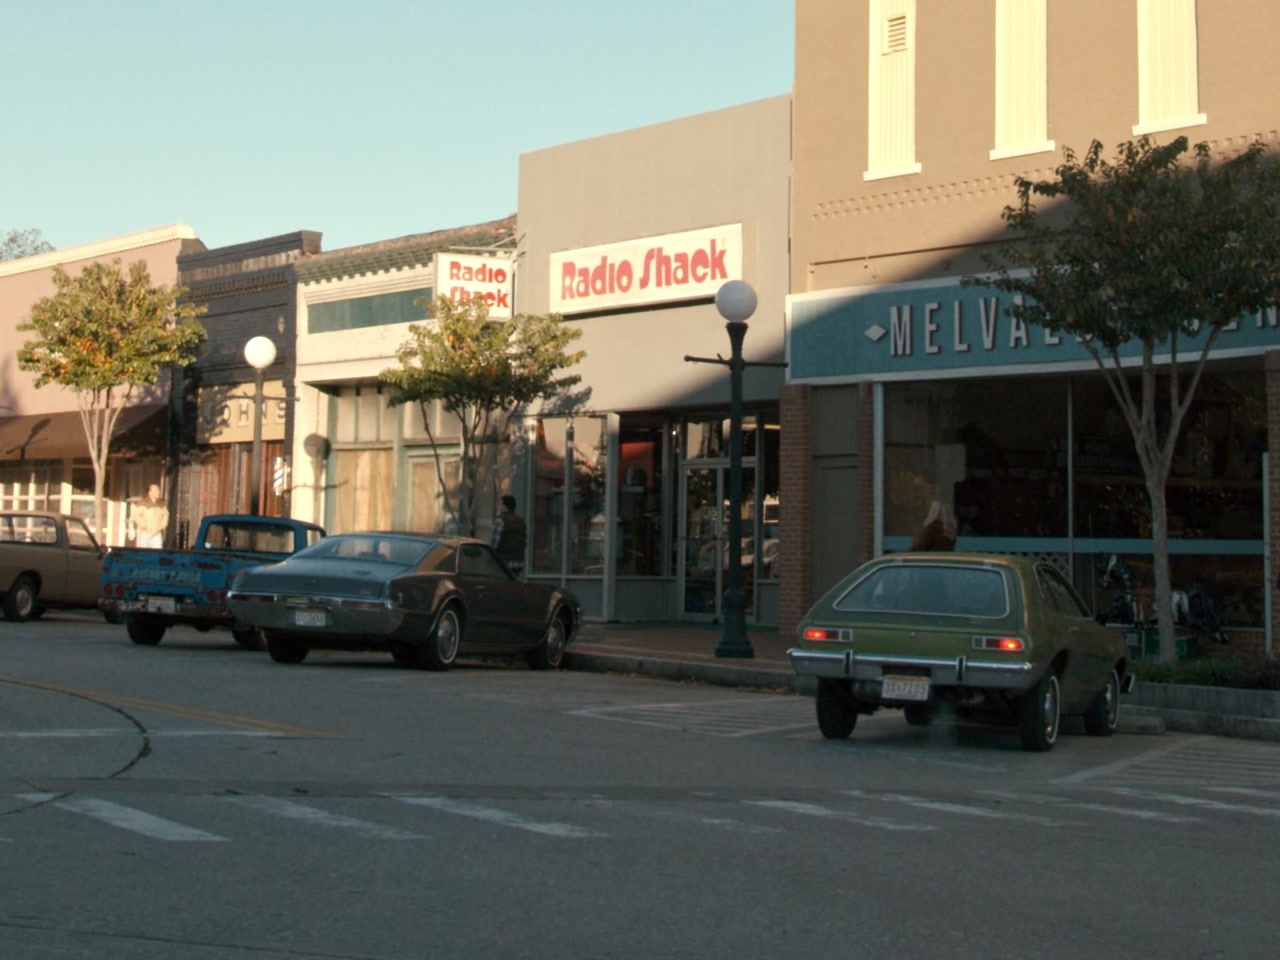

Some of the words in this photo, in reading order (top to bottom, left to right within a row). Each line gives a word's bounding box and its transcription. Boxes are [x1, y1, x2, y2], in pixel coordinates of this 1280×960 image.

[449, 261, 507, 284] Radio
[561, 255, 633, 300] Radio
[639, 239, 728, 290] Shack
